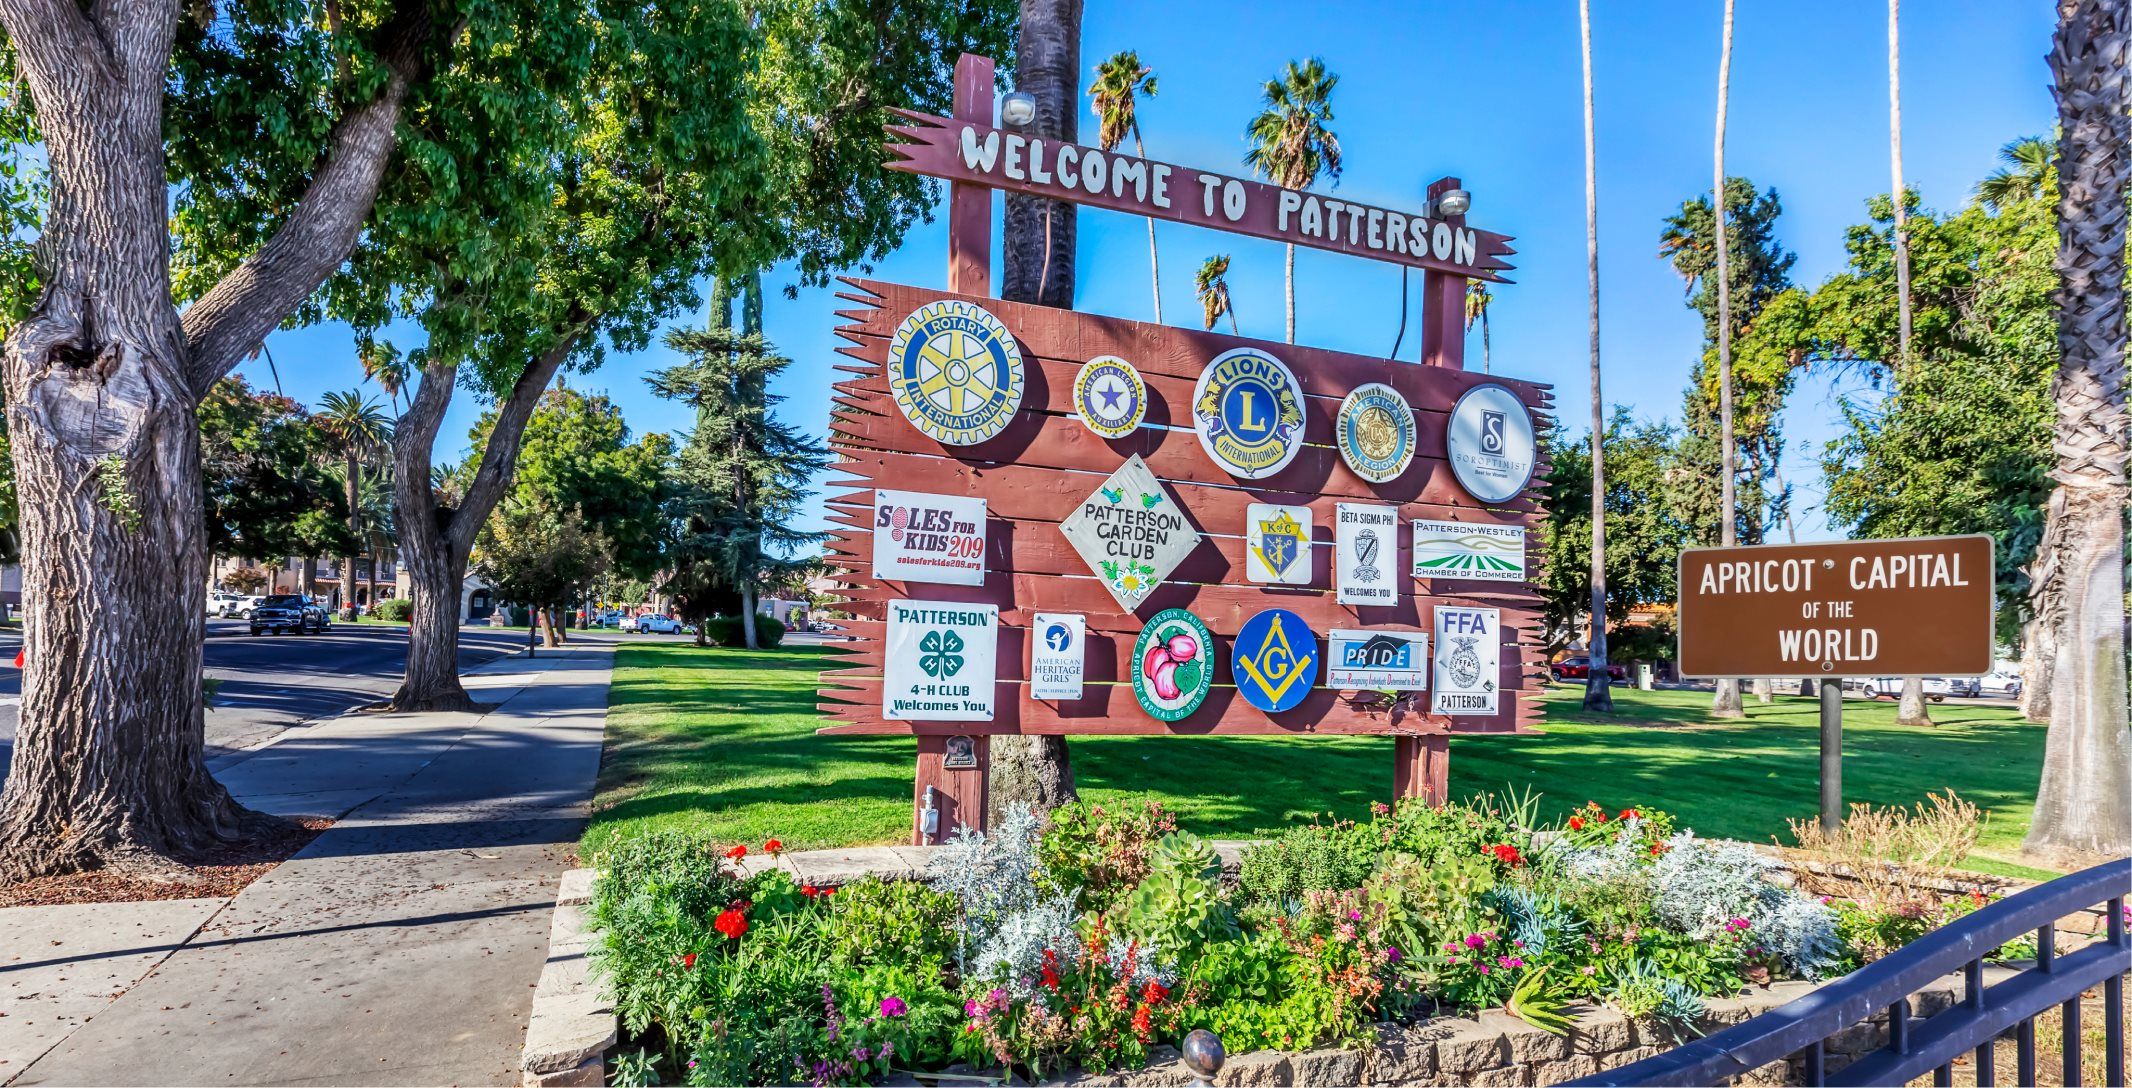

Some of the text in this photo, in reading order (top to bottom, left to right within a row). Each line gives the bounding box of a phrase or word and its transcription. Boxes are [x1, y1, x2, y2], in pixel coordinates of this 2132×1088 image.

[961, 126, 1476, 266] WELCOME TO PATTERSON
[931, 318, 986, 337] ROTARY
[1220, 359, 1281, 386] LIONS
[1085, 368, 1136, 398] AMERICAN LEGION
[910, 387, 1003, 428] INTERNATIONAL
[1239, 390, 1266, 431] L
[1352, 397, 1404, 427] AMERICAN
[1092, 413, 1130, 427] AUXILIARY
[1220, 440, 1280, 463] INTERNATIONAL
[1358, 454, 1396, 469] LEGION
[1456, 453, 1527, 471] SOROPTIMIST
[877, 505, 976, 534] SOLES FOR
[1085, 503, 1182, 531] PATTERSON
[1341, 511, 1393, 525] BETA SIGMA PHI
[1097, 522, 1168, 545] GARDEN
[904, 532, 984, 558] KIDS 209
[1106, 540, 1155, 560] CLUB
[897, 557, 981, 570] solesforkids209.org
[1415, 568, 1457, 576] CHAMBER
[1475, 570, 1522, 579] COMMERCE
[1700, 553, 1969, 595] APRICOT CAPITAL
[1344, 587, 1391, 598] WELCOMES YOU
[899, 609, 988, 626] PATTERSON
[1802, 601, 1854, 619] OF THE
[1444, 611, 1487, 634] FFA
[1183, 612, 1212, 657] CALIFORNIA
[1779, 628, 1878, 662] WORLD
[1036, 657, 1080, 665] AMERICAN
[1263, 646, 1288, 679] G
[1345, 648, 1406, 666] PRIDE
[1035, 665, 1081, 674] HERITAGE
[1042, 674, 1069, 682] GIRLS
[911, 684, 970, 696] 4-H CLUB
[1132, 653, 1212, 718] APRICOT CAPITAL OF THE WORLD
[893, 700, 986, 711] Welcomes You
[1441, 695, 1487, 708] PATTERSON
